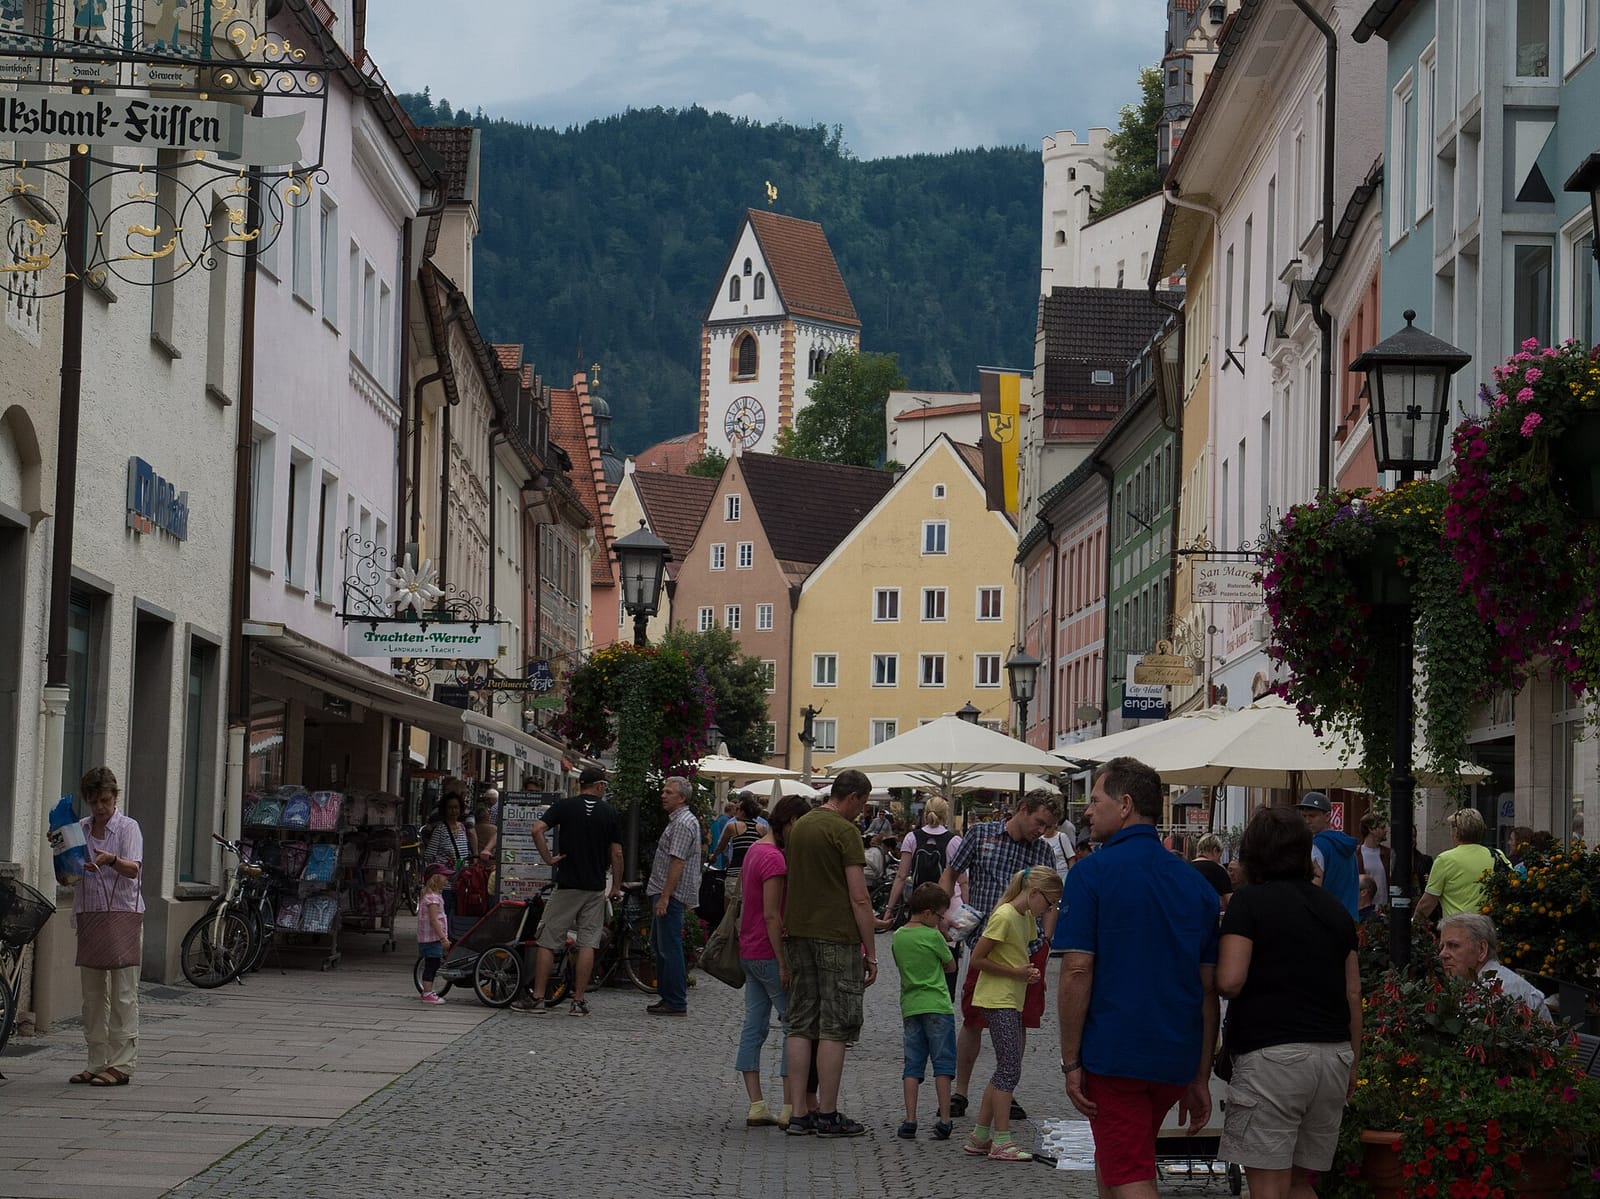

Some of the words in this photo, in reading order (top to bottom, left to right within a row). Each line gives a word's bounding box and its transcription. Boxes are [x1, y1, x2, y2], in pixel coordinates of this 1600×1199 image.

[72, 66, 101, 77] Handel
[149, 71, 184, 82] Gewerbe
[1200, 567, 1220, 581] San
[364, 631, 482, 644] Trachten-Werner
[1150, 668, 1179, 678] Hotel
[488, 679, 529, 690] Parfümerie
